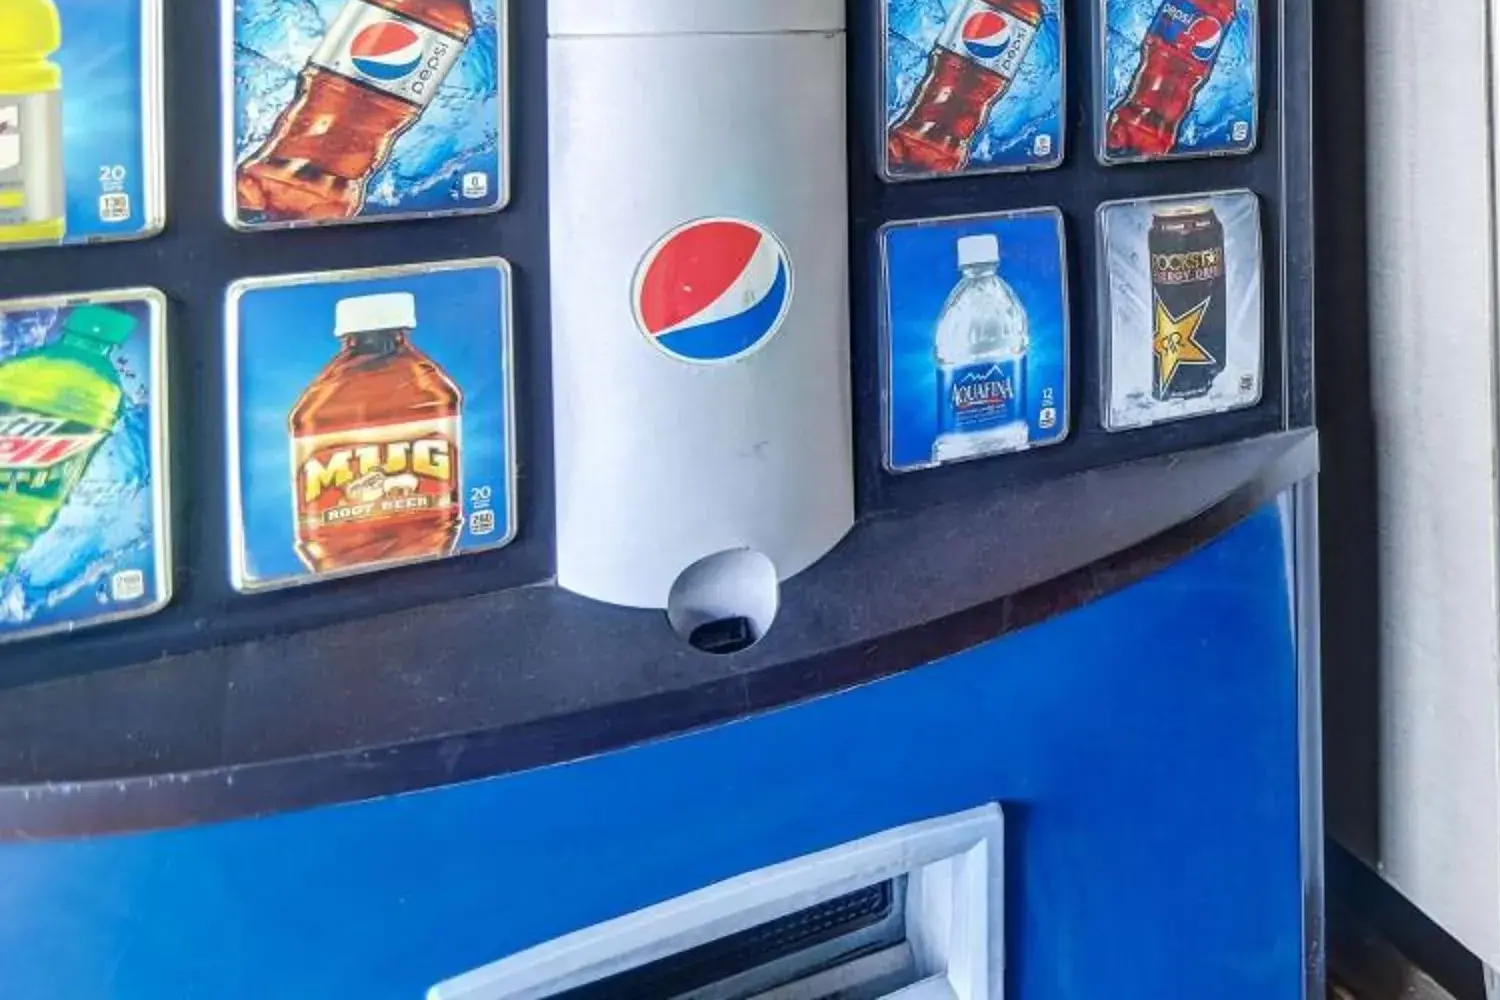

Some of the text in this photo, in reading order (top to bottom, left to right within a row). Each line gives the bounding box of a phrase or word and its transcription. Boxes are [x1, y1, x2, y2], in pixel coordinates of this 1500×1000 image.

[1000, 27, 1027, 71] pepsi
[411, 41, 449, 95] pepsi
[99, 165, 126, 181] 20
[952, 376, 1015, 407] AQUAFINA
[305, 439, 450, 503] MUG
[470, 485, 491, 500] 20
[327, 496, 429, 522] ROOT BEER
